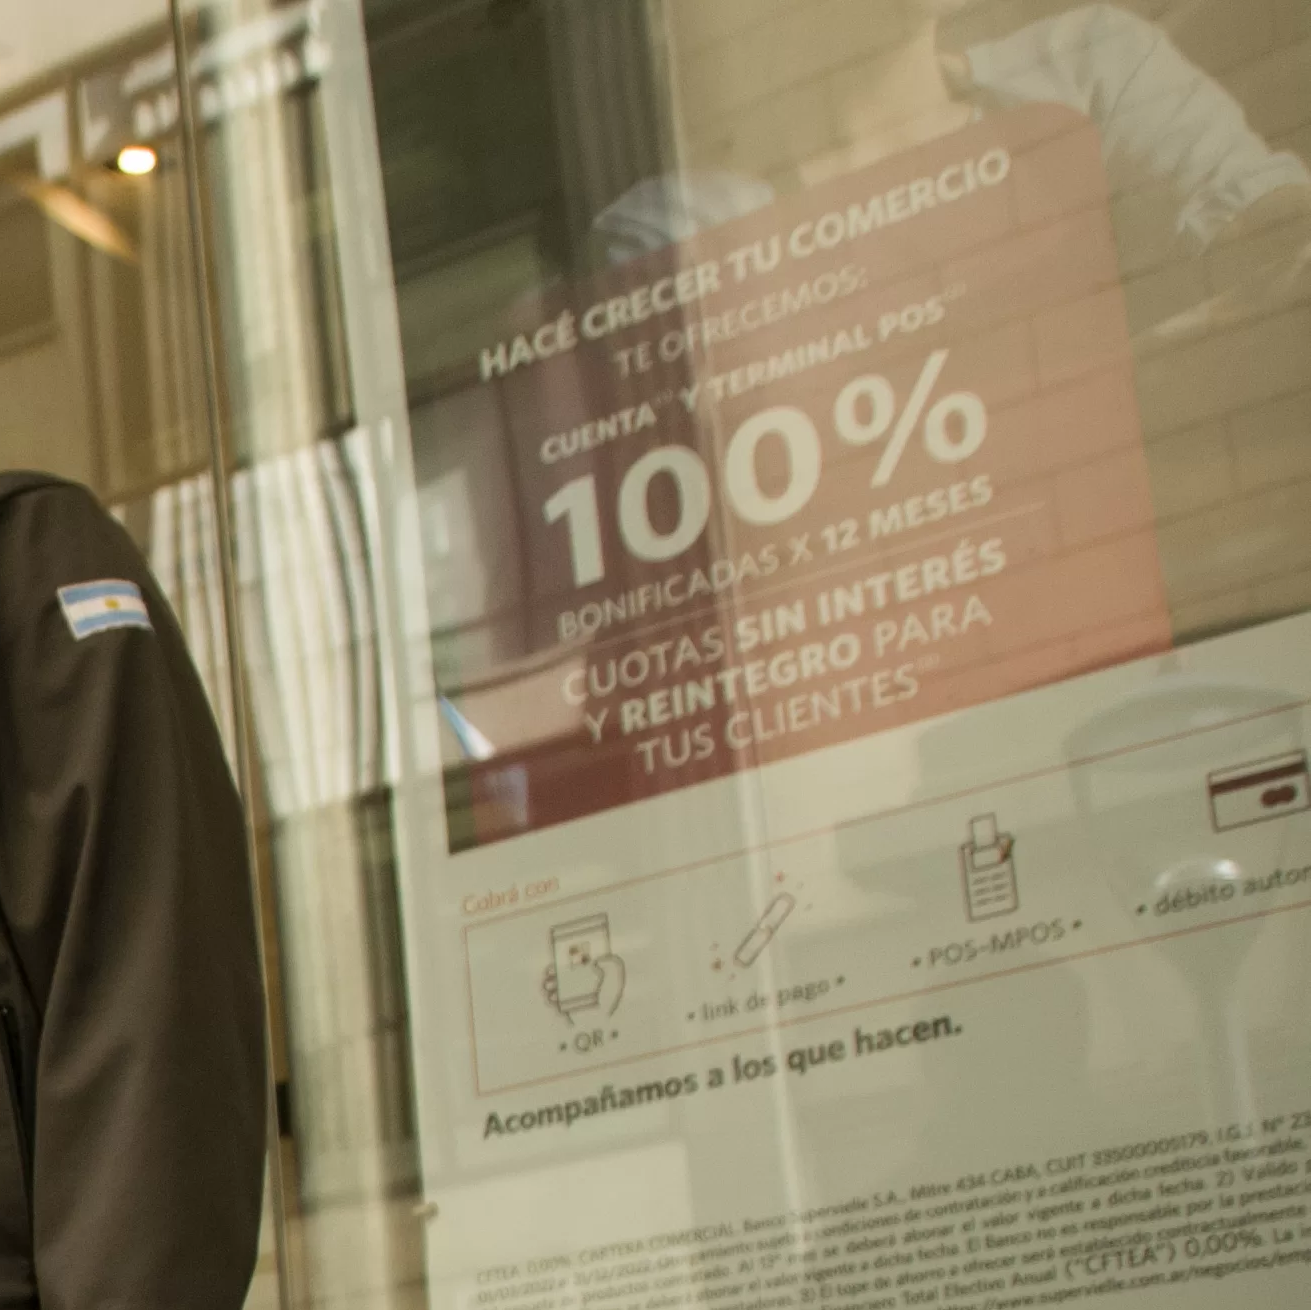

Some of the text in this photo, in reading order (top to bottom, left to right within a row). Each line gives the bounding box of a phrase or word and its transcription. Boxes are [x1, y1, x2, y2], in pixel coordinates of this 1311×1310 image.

[479, 148, 1010, 382] HACÉ CRECER TU COMERCIO
[614, 264, 868, 379] TE OFRECEMOS:
[540, 296, 945, 465] CUENTA Y TERMINAL POS
[543, 348, 987, 588] 100%
[558, 545, 778, 642] BONIFICADAS
[820, 520, 860, 556] 12
[870, 474, 992, 540] MESES
[562, 538, 1006, 704] CUOTAS SIN INTERÉS
[585, 595, 993, 743] Y REINTEGRO PARA
[638, 663, 919, 774] TUS CLIENTES
[525, 877, 560, 898] con
[575, 1029, 604, 1052] QR
[702, 1001, 740, 1022] link
[777, 982, 830, 1008] pago
[483, 1014, 963, 1139] Acompañamos a los que hacen.
